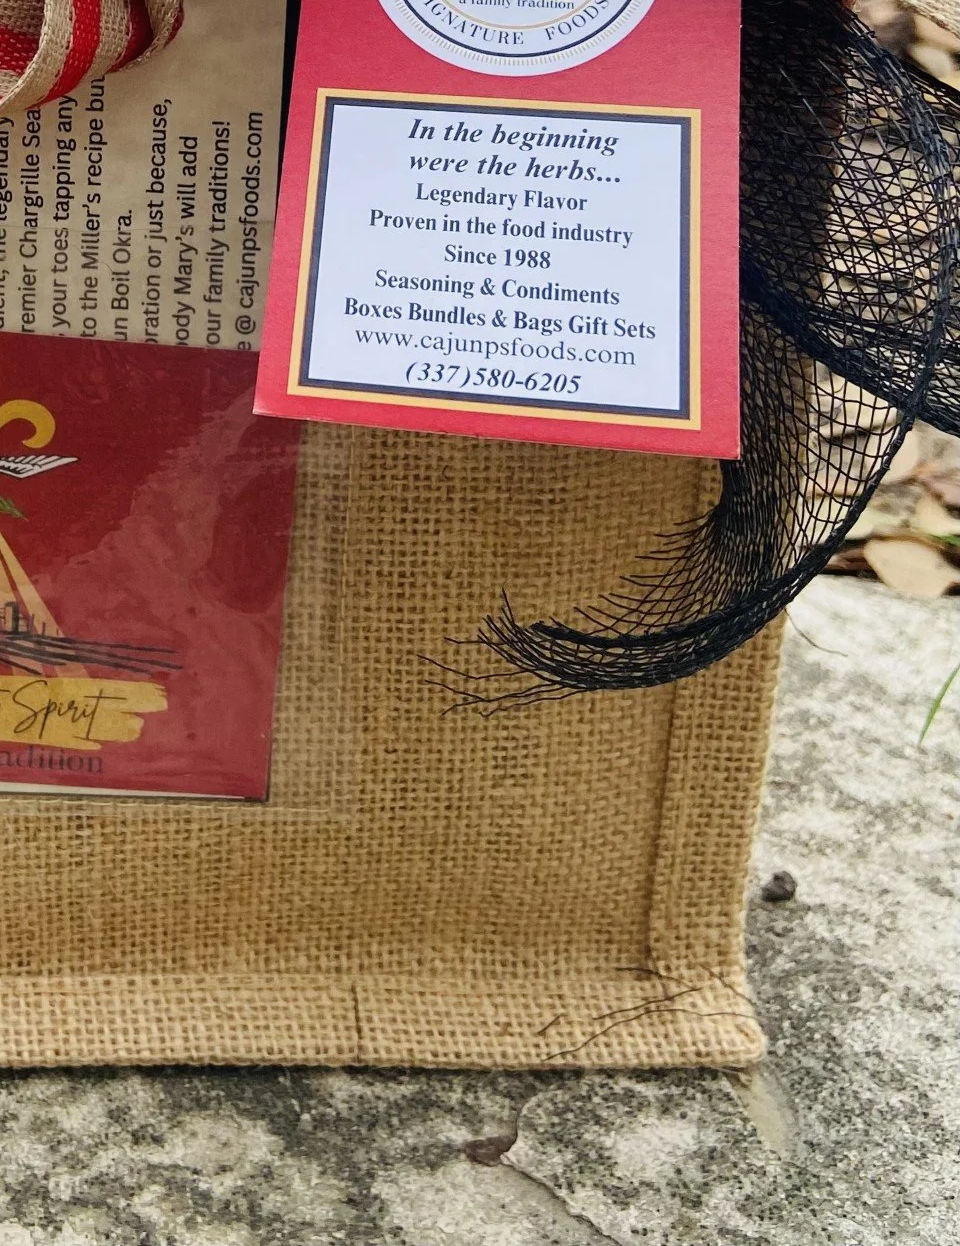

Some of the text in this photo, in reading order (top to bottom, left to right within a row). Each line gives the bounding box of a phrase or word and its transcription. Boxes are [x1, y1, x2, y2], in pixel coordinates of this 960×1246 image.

[57, 95, 78, 133] any
[84, 118, 107, 189] recipe
[146, 98, 172, 194] because,
[408, 118, 620, 156] In the beginning
[52, 138, 76, 222] tapping
[409, 154, 621, 184] were the herbs...
[19, 154, 44, 258] Chargrille
[236, 112, 264, 309] cajunpsfoods.com
[415, 183, 588, 212] Legendary Flavor
[81, 192, 100, 270] Miller's
[112, 209, 132, 264] Okra.
[144, 200, 167, 242] just
[172, 136, 198, 346] ody Mary's will add
[203, 121, 230, 347] our family traditions!
[369, 209, 634, 248] Proven in the food industry
[53, 228, 69, 274] toes
[147, 246, 162, 267] or
[444, 245, 552, 270] Since 1988
[18, 265, 37, 333] remier
[52, 273, 71, 328] your
[80, 275, 98, 310] the
[111, 269, 130, 310] Boil
[374, 269, 621, 305] Seasoning & Condiments
[80, 317, 97, 337] to
[235, 315, 256, 334] @
[344, 297, 657, 340] Boxes Bundles & Bags Gift Sets
[355, 327, 636, 366] www.cajunpsfoods.com
[406, 361, 582, 395] (337)580-6205
[12, 680, 127, 739] Spirit
